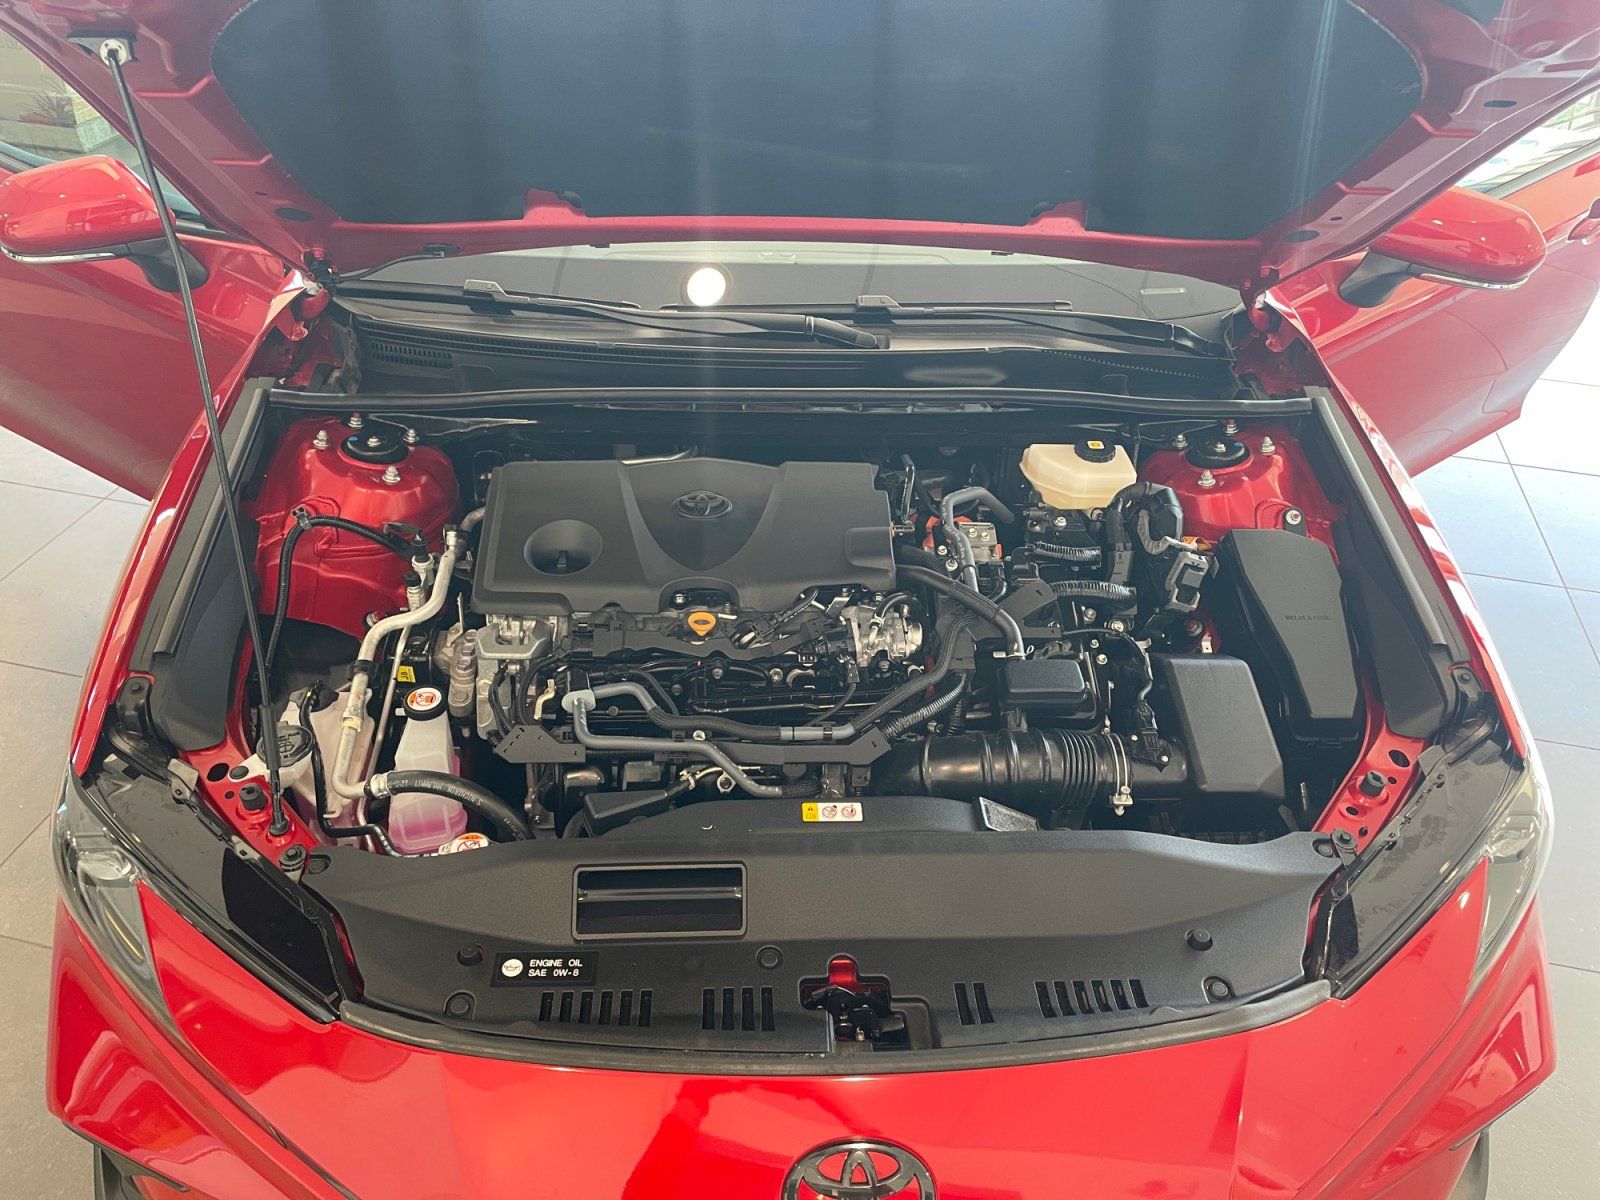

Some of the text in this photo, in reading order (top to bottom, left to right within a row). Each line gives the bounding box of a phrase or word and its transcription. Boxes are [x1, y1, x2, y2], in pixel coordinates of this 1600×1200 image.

[529, 959, 583, 967] ENGINE OIL
[528, 969, 579, 977] SAE 0W-8
